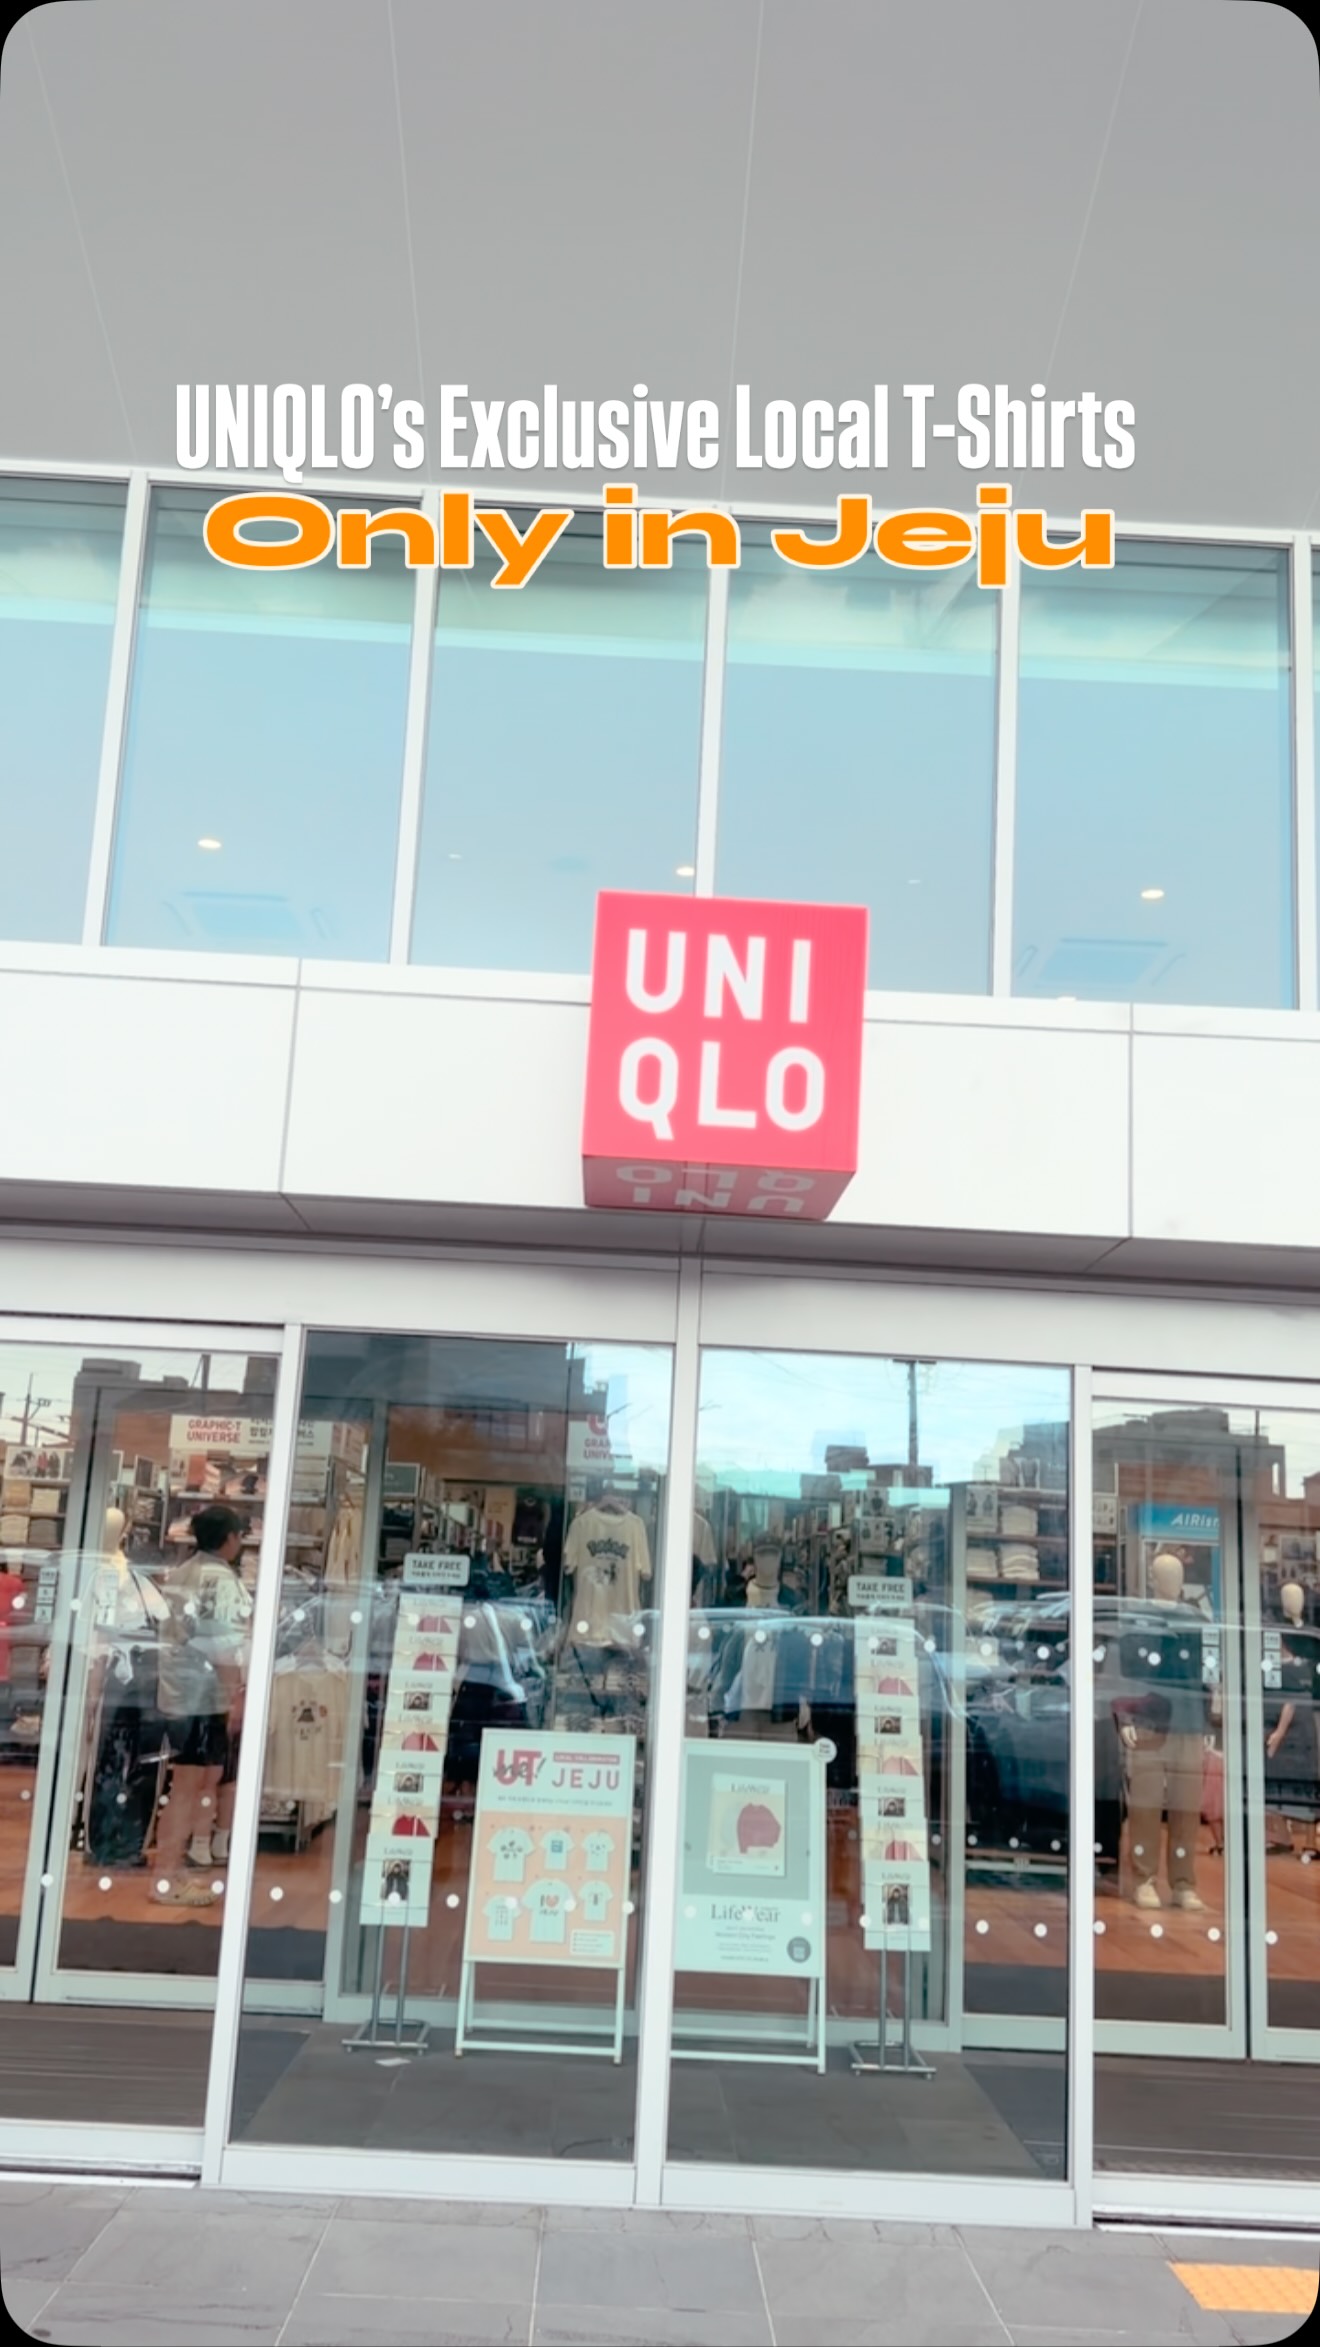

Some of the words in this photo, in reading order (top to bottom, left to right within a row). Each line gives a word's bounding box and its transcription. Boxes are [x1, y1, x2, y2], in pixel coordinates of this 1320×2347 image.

[626, 928, 811, 1023] UNI
[618, 1037, 825, 1141] QLO
[616, 1165, 816, 1192] QLO
[633, 1187, 805, 1212] UNI
[186, 1430, 241, 1444] UNIVERSE
[412, 1560, 434, 1569] TAKE
[438, 1561, 462, 1570] FREE
[856, 1582, 879, 1592] TAKE
[881, 1583, 905, 1593] FREE
[551, 1768, 620, 1790] JEJU
